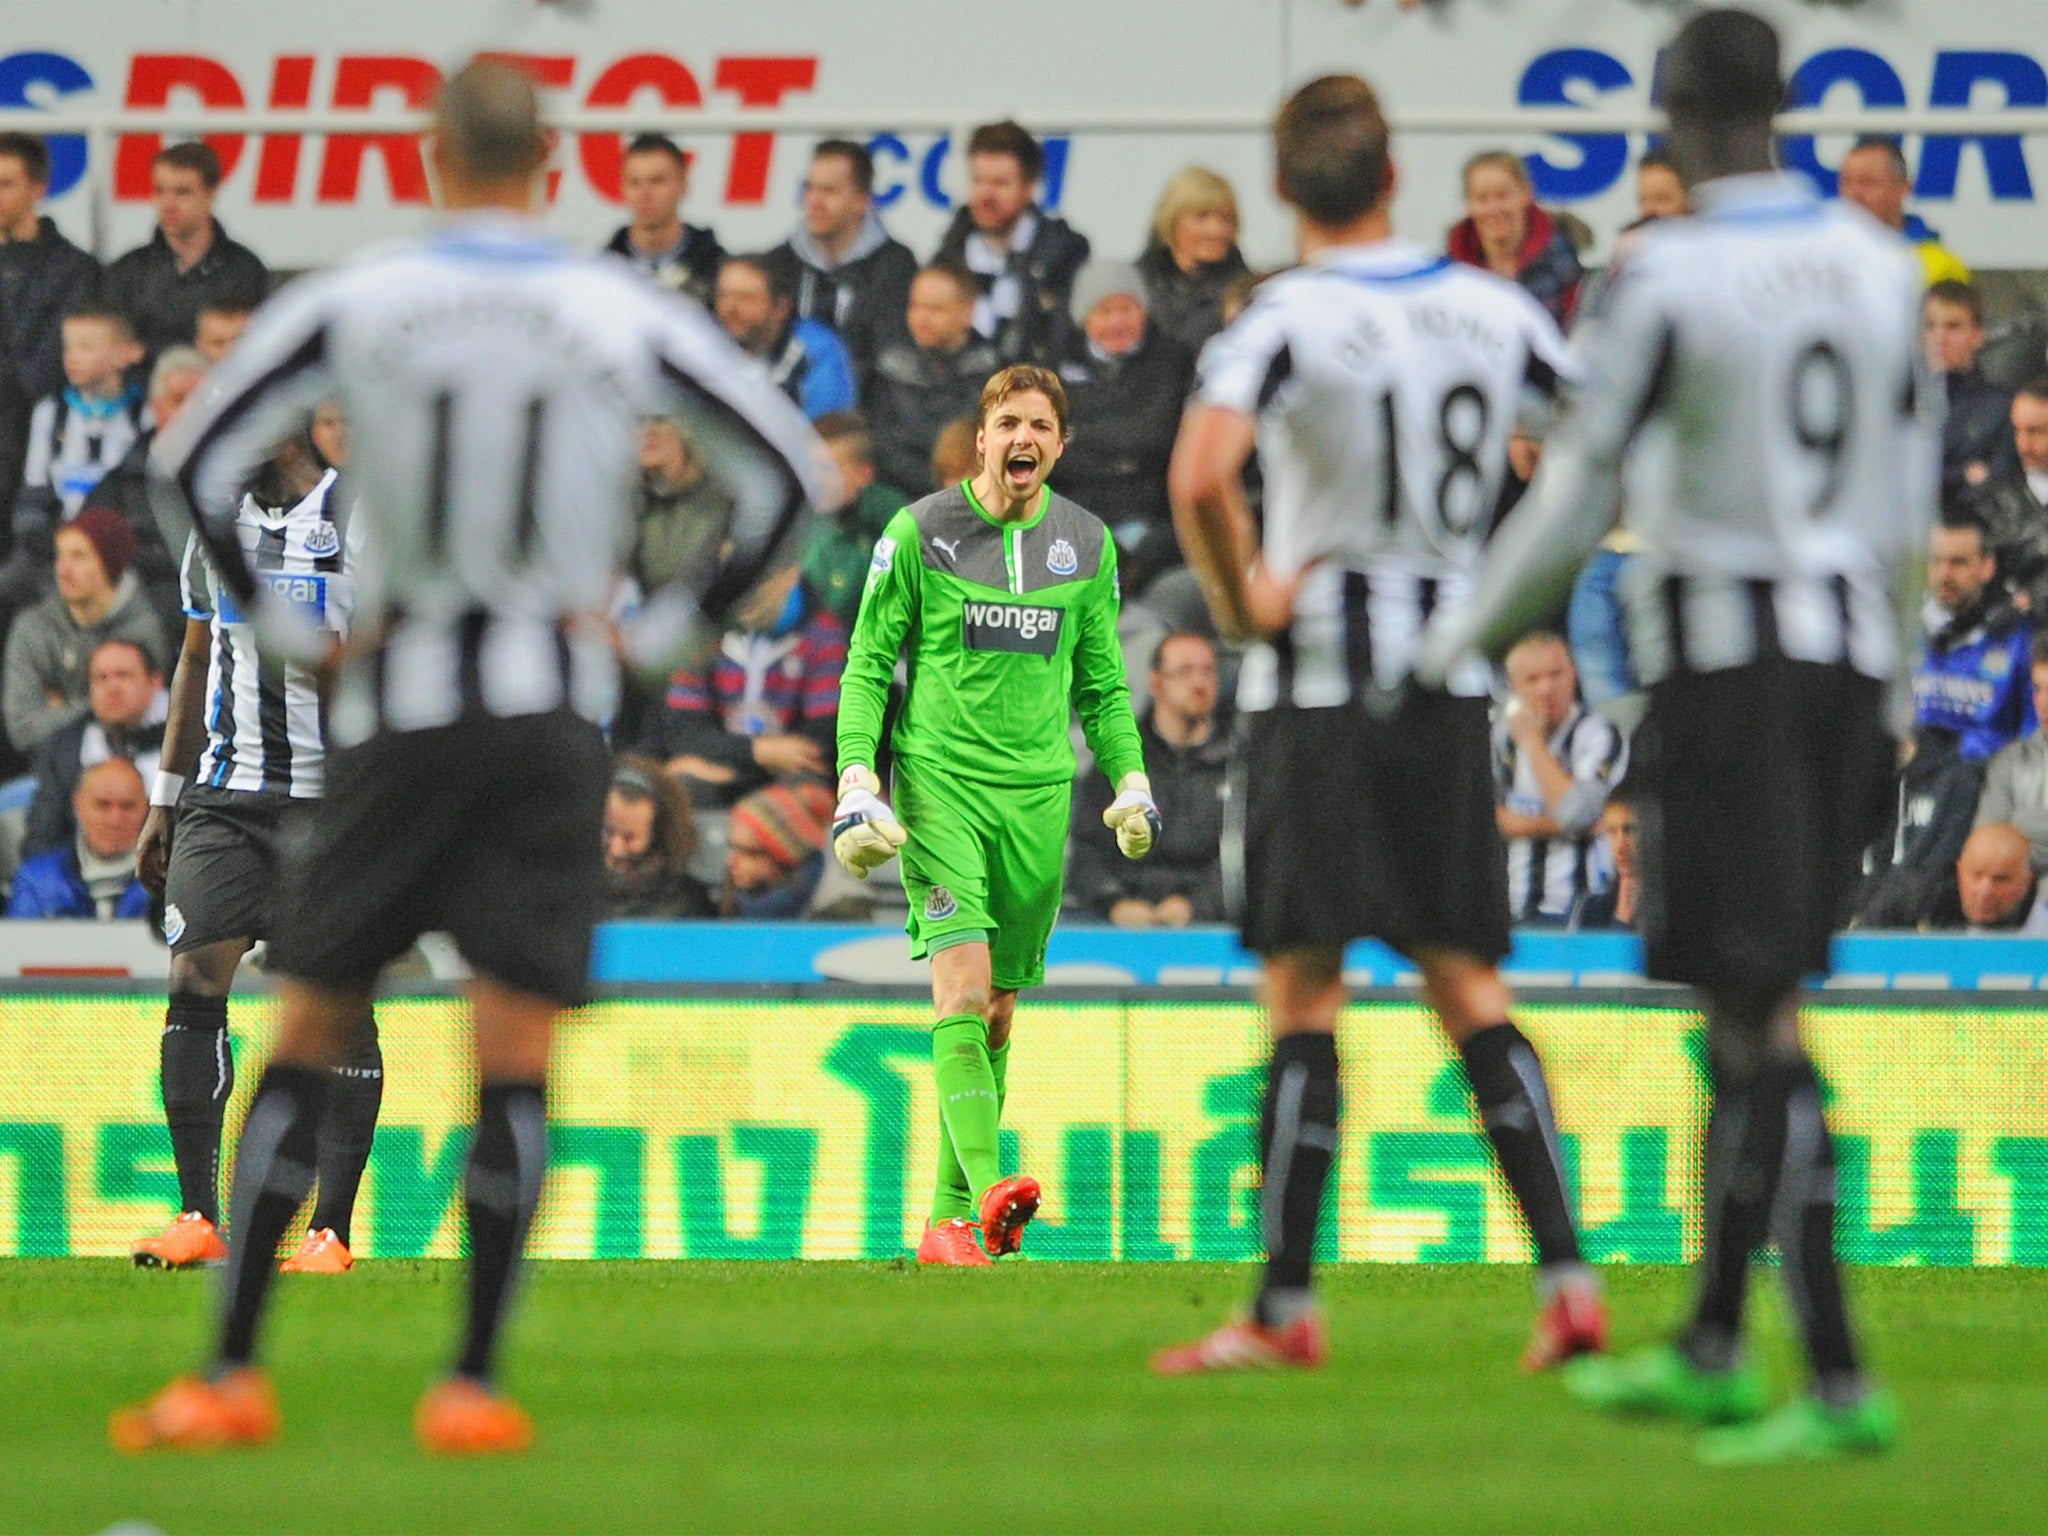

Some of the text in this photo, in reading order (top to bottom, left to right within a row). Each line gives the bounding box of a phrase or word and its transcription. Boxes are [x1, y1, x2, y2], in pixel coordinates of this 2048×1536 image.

[1517, 46, 2048, 204] SOR
[426, 383, 550, 562] 11
[1379, 384, 1490, 540] 18
[1786, 337, 1854, 523] 9
[964, 604, 1052, 639] wonga
